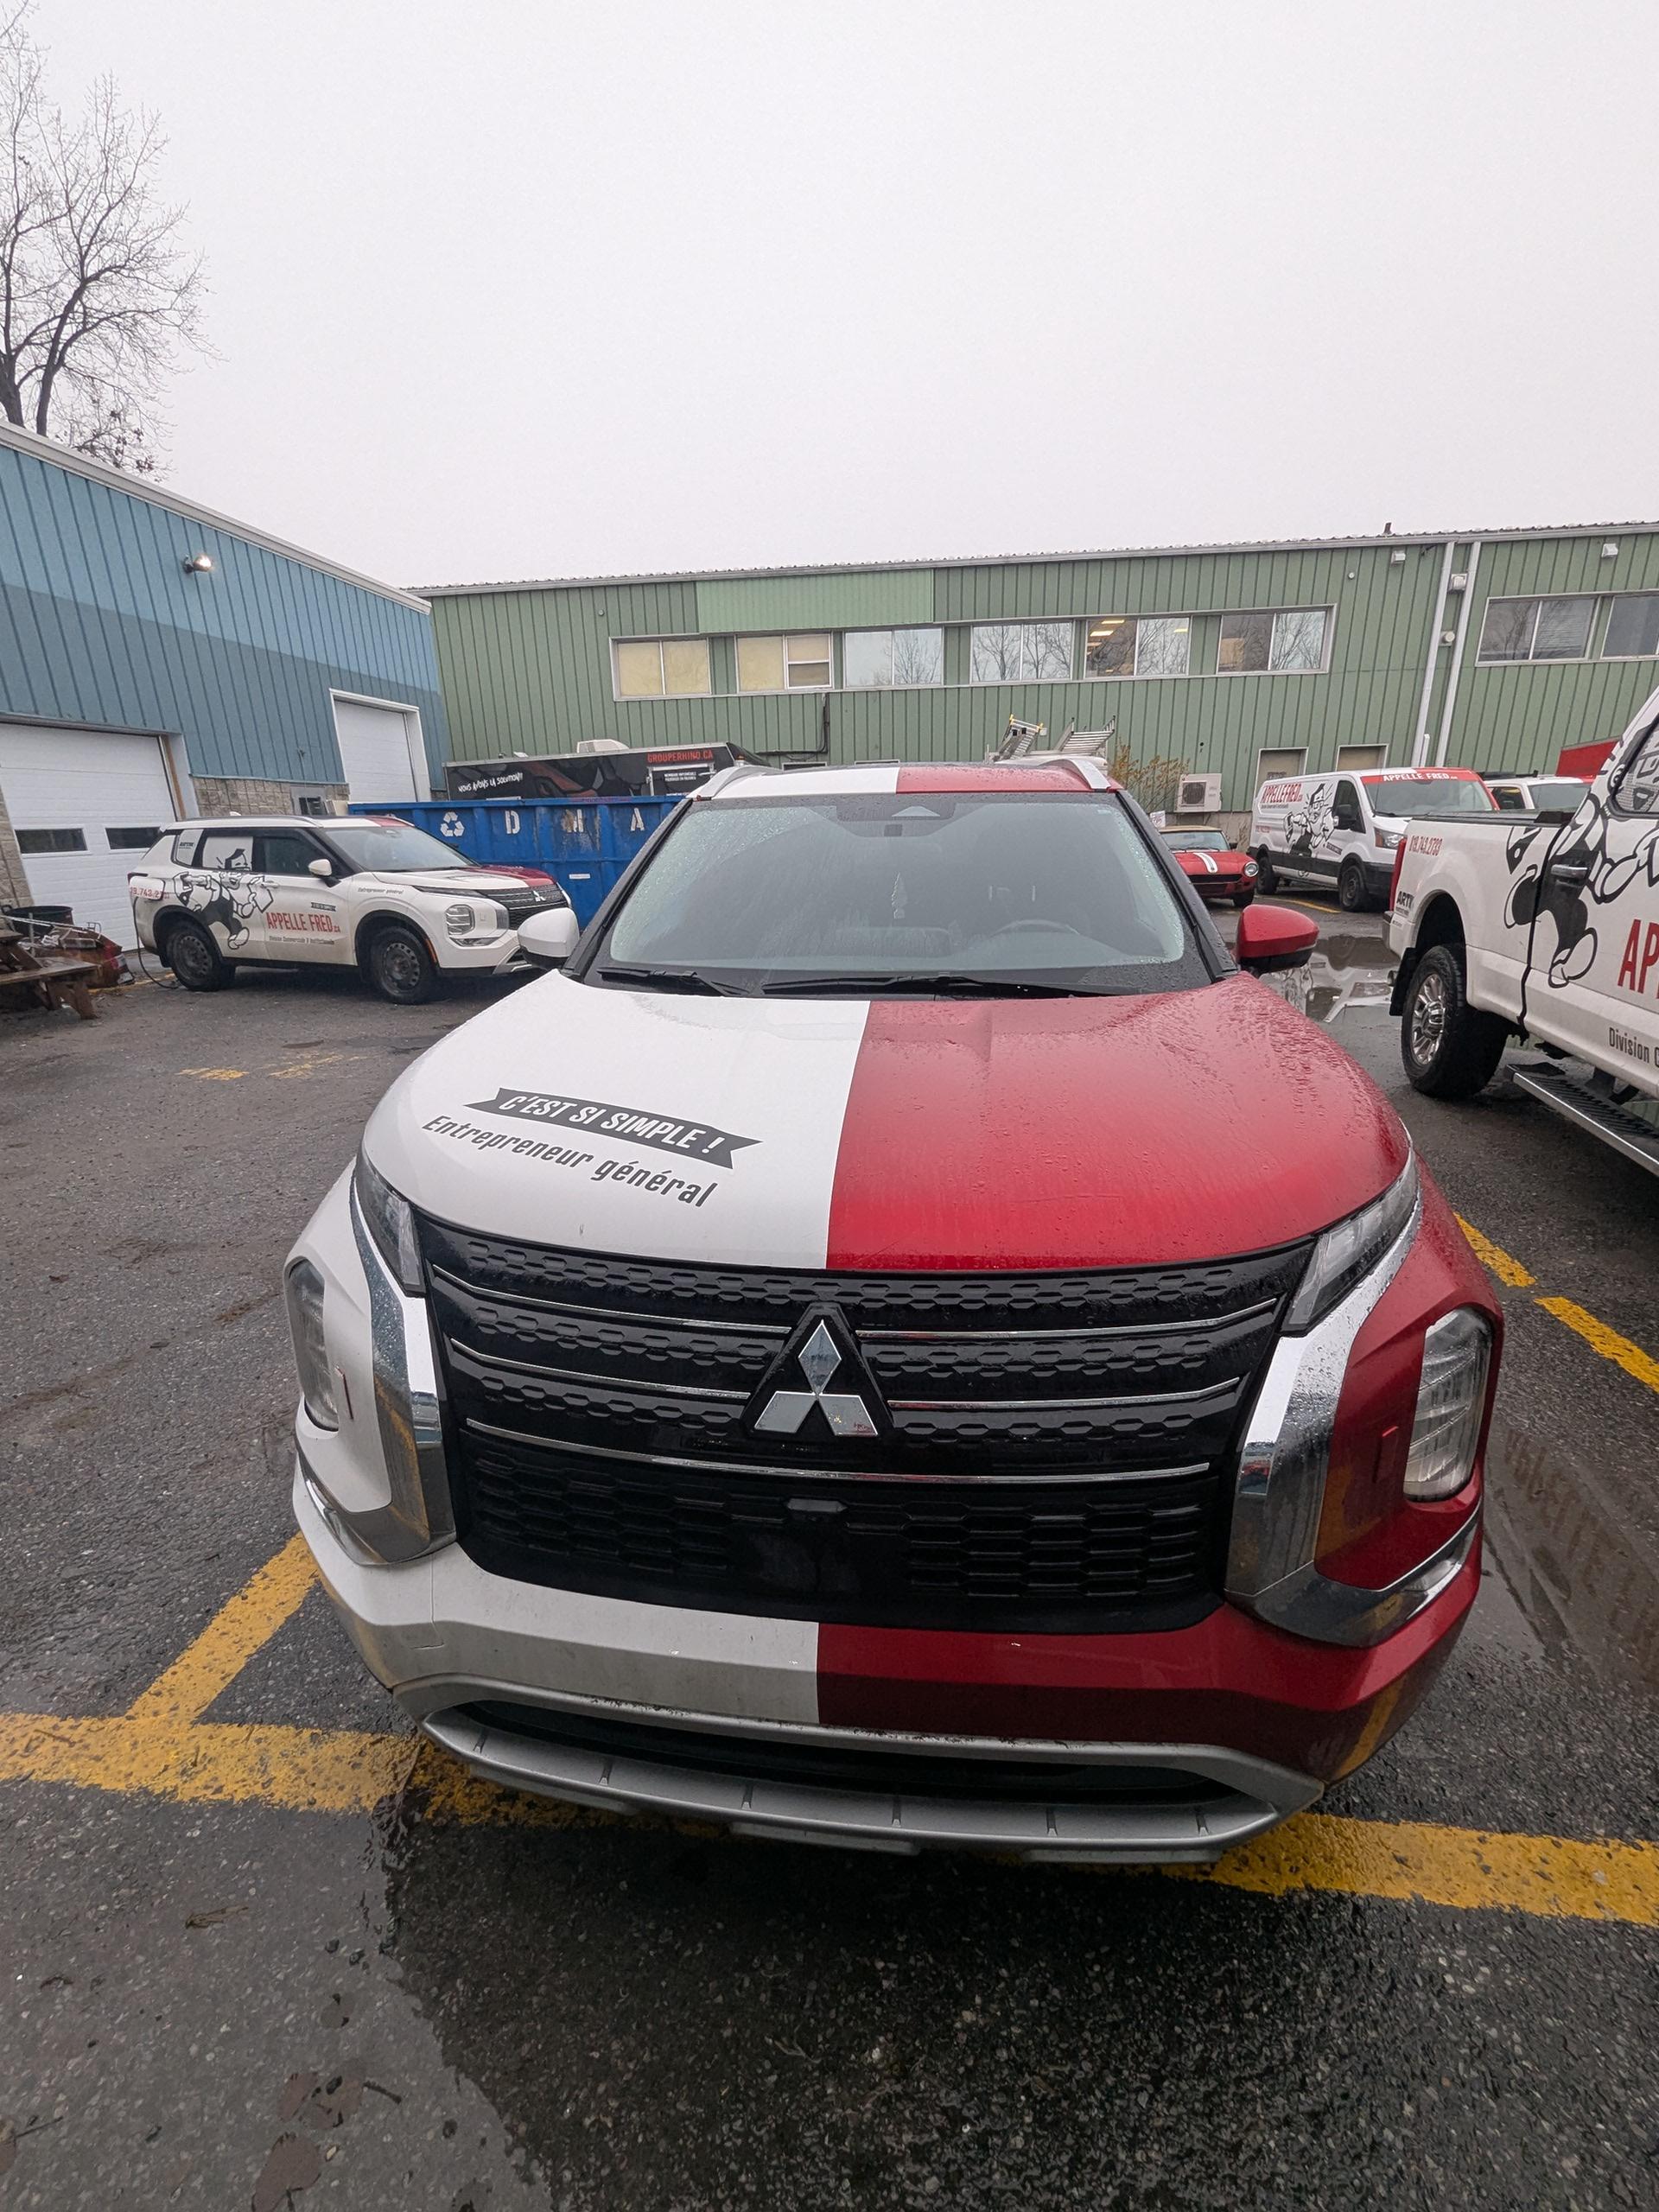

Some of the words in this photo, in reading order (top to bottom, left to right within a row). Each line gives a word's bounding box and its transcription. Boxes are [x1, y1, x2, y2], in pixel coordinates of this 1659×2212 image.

[647, 748, 714, 764] GROUPERHINO.CA
[1382, 772, 1424, 782] APPELLE
[505, 809, 521, 835] D
[630, 807, 645, 831] A
[265, 912, 308, 931] APPELLE
[1617, 918, 1659, 999] AP
[1609, 1027, 1650, 1064] Division
[498, 1093, 573, 1121] C'EST
[569, 1105, 604, 1124] SI
[601, 1111, 707, 1150] SIMPLE
[421, 1115, 594, 1171] Entrepreneur
[590, 1160, 719, 1208] général
